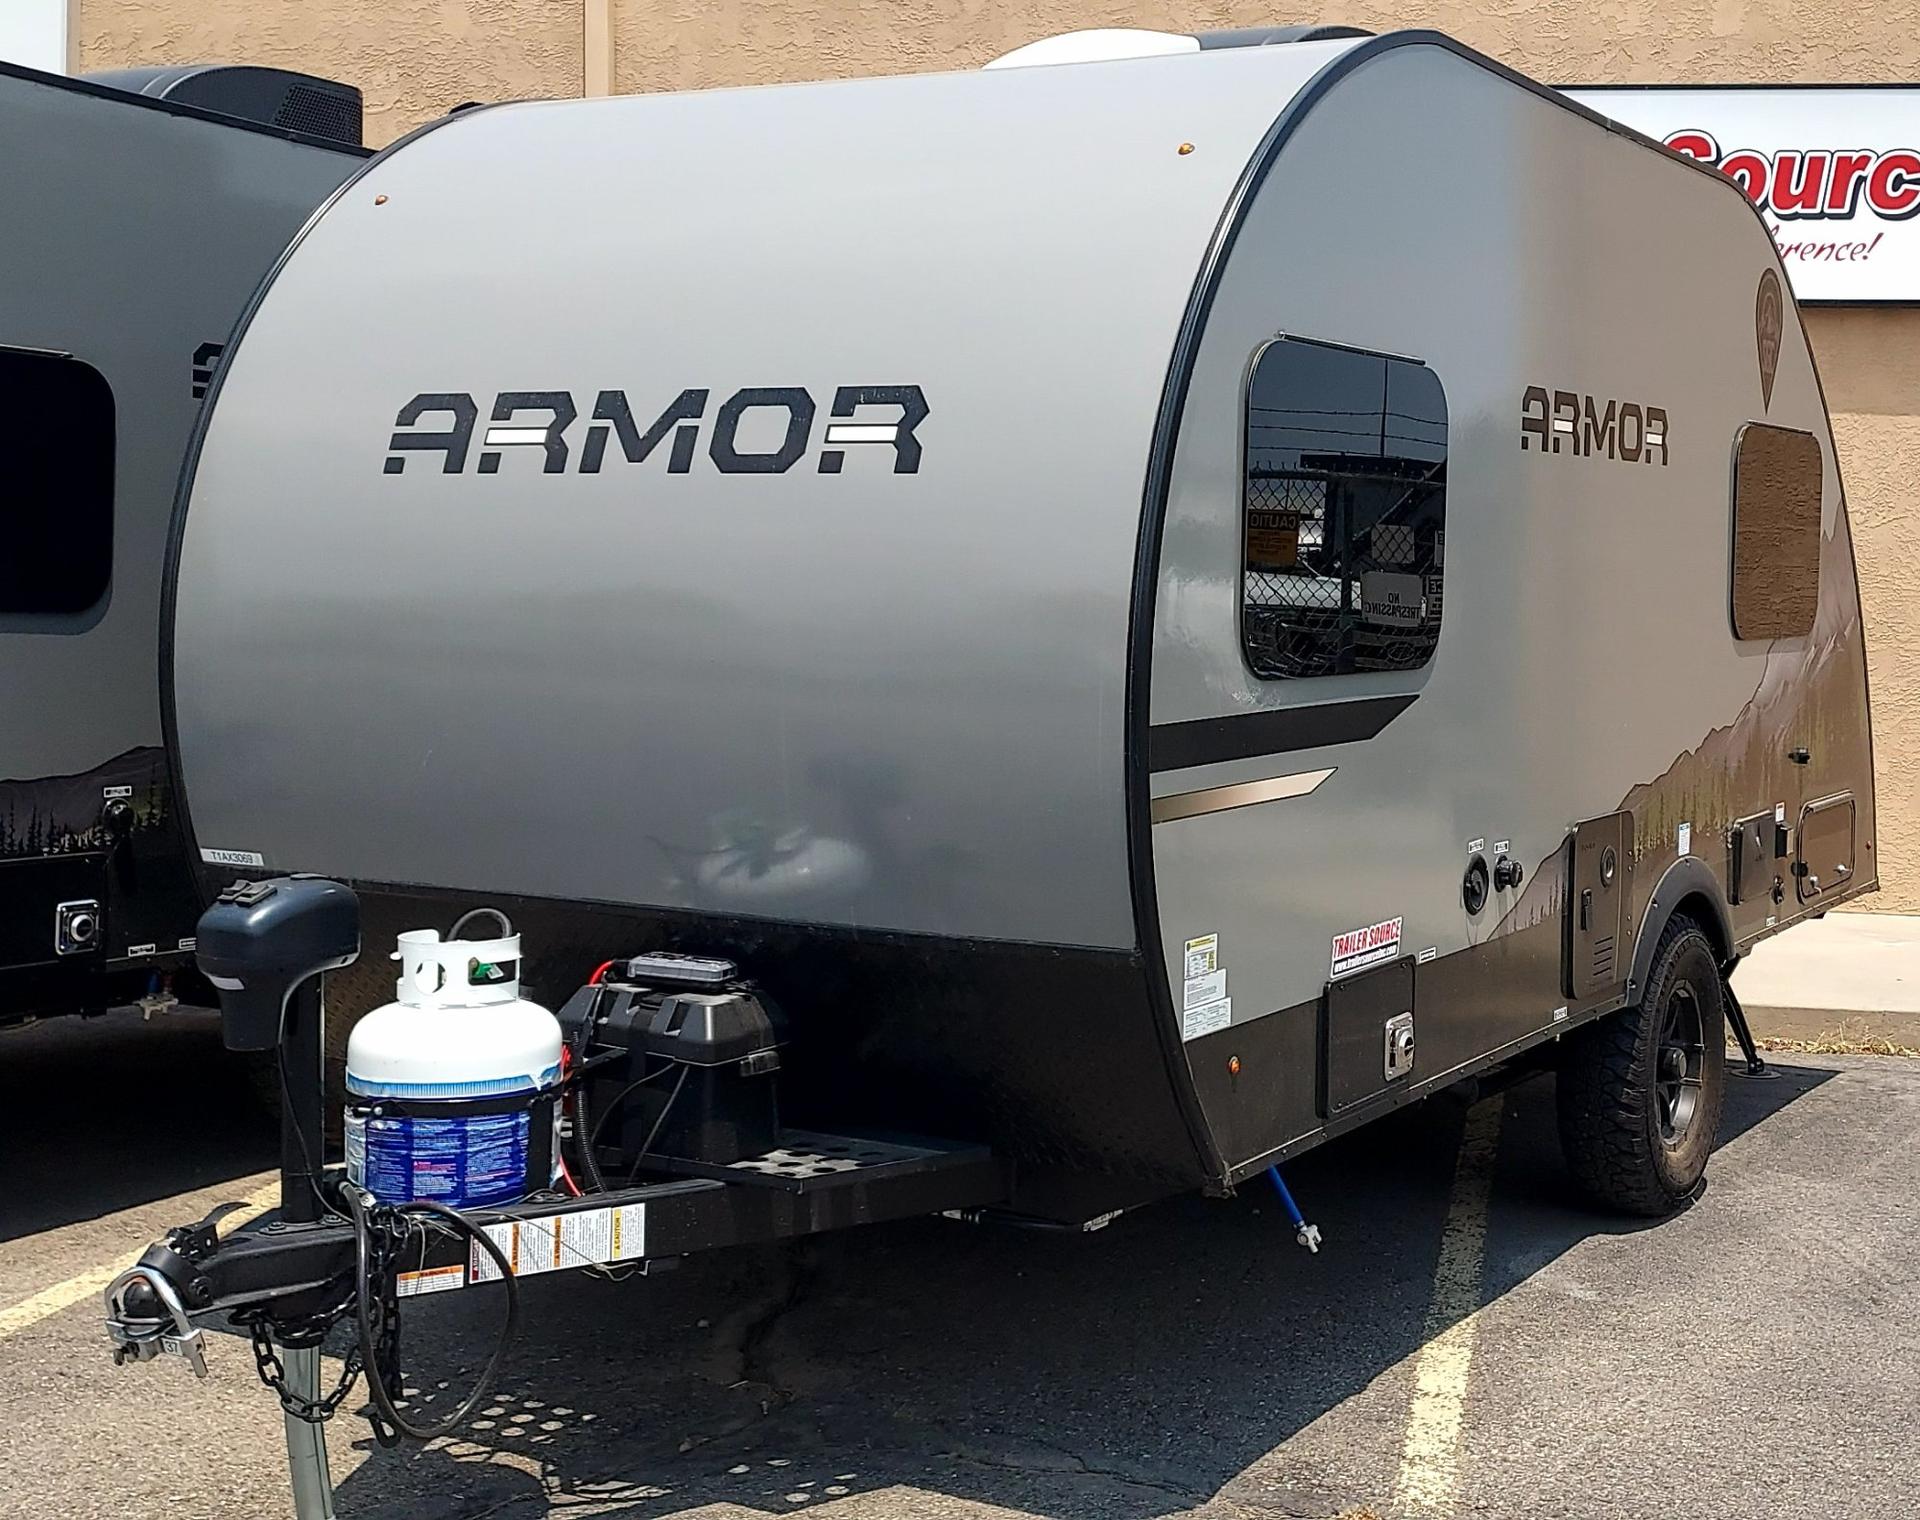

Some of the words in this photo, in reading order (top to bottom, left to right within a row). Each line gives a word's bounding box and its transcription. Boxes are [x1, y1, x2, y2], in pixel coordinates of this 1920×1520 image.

[383, 384, 931, 474] ARMOR
[1521, 385, 1669, 466] ARMOR
[1333, 931, 1368, 958] TRAILER
[1369, 920, 1401, 948] SOURCE
